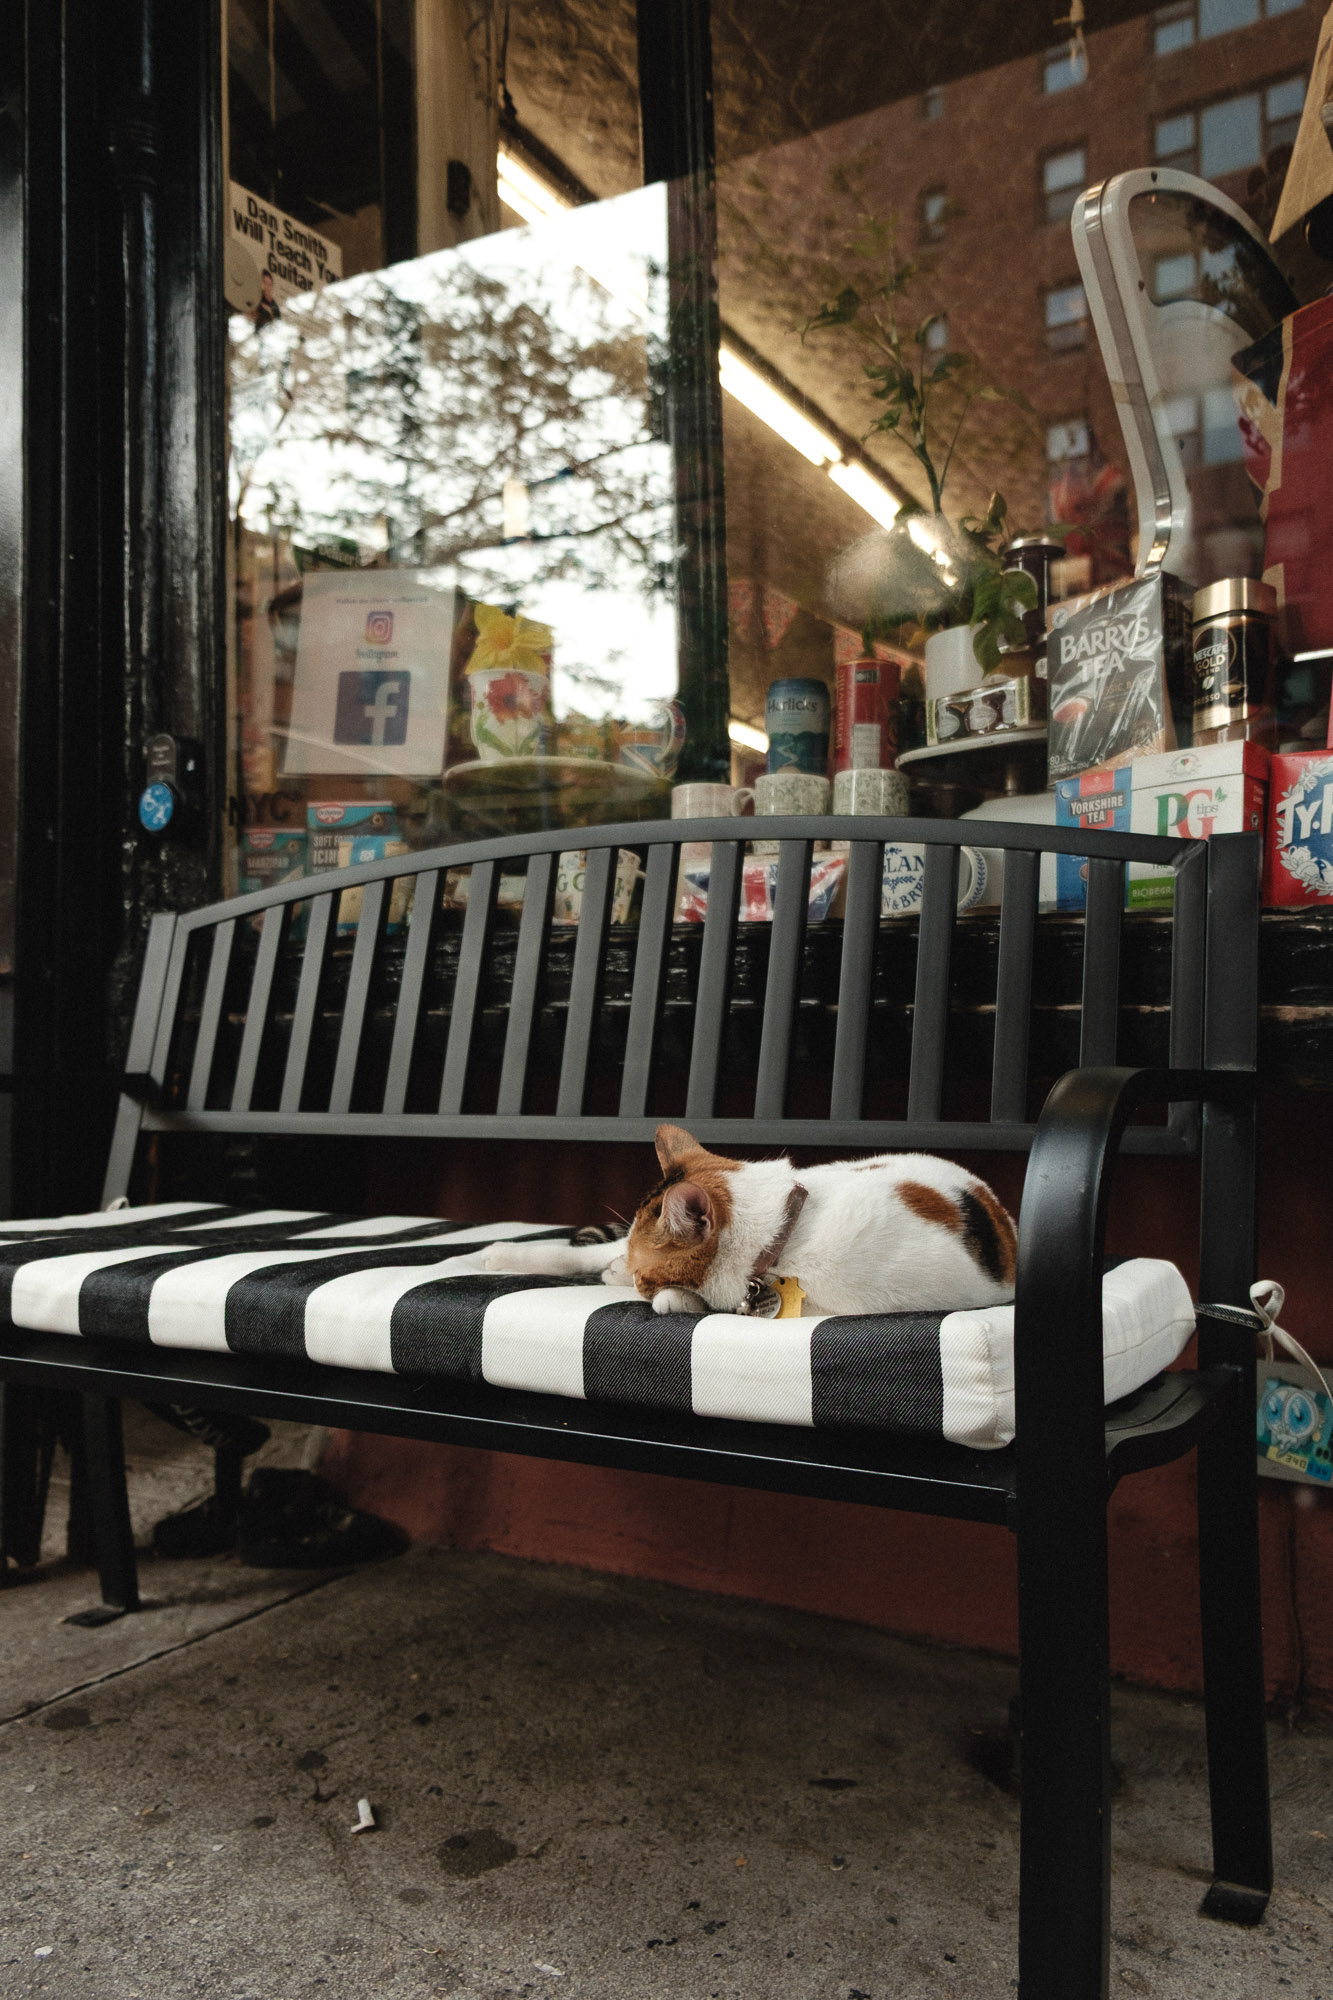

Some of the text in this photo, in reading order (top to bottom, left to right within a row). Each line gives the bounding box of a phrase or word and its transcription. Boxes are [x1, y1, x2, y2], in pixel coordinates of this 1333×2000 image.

[247, 196, 328, 262] Dan Smith
[233, 208, 341, 284] Will Teach Yo
[267, 252, 314, 292] Guitar
[1077, 651, 1126, 683] TEA
[1194, 654, 1226, 672] GOLD
[767, 697, 818, 714] Horlicks
[1070, 794, 1124, 816] YORKSHIRE
[1154, 789, 1218, 841] PG
[1196, 803, 1219, 817] tips
[1087, 810, 1105, 824] TEA
[313, 835, 332, 847] SOFT
[313, 850, 337, 864] ICIN
